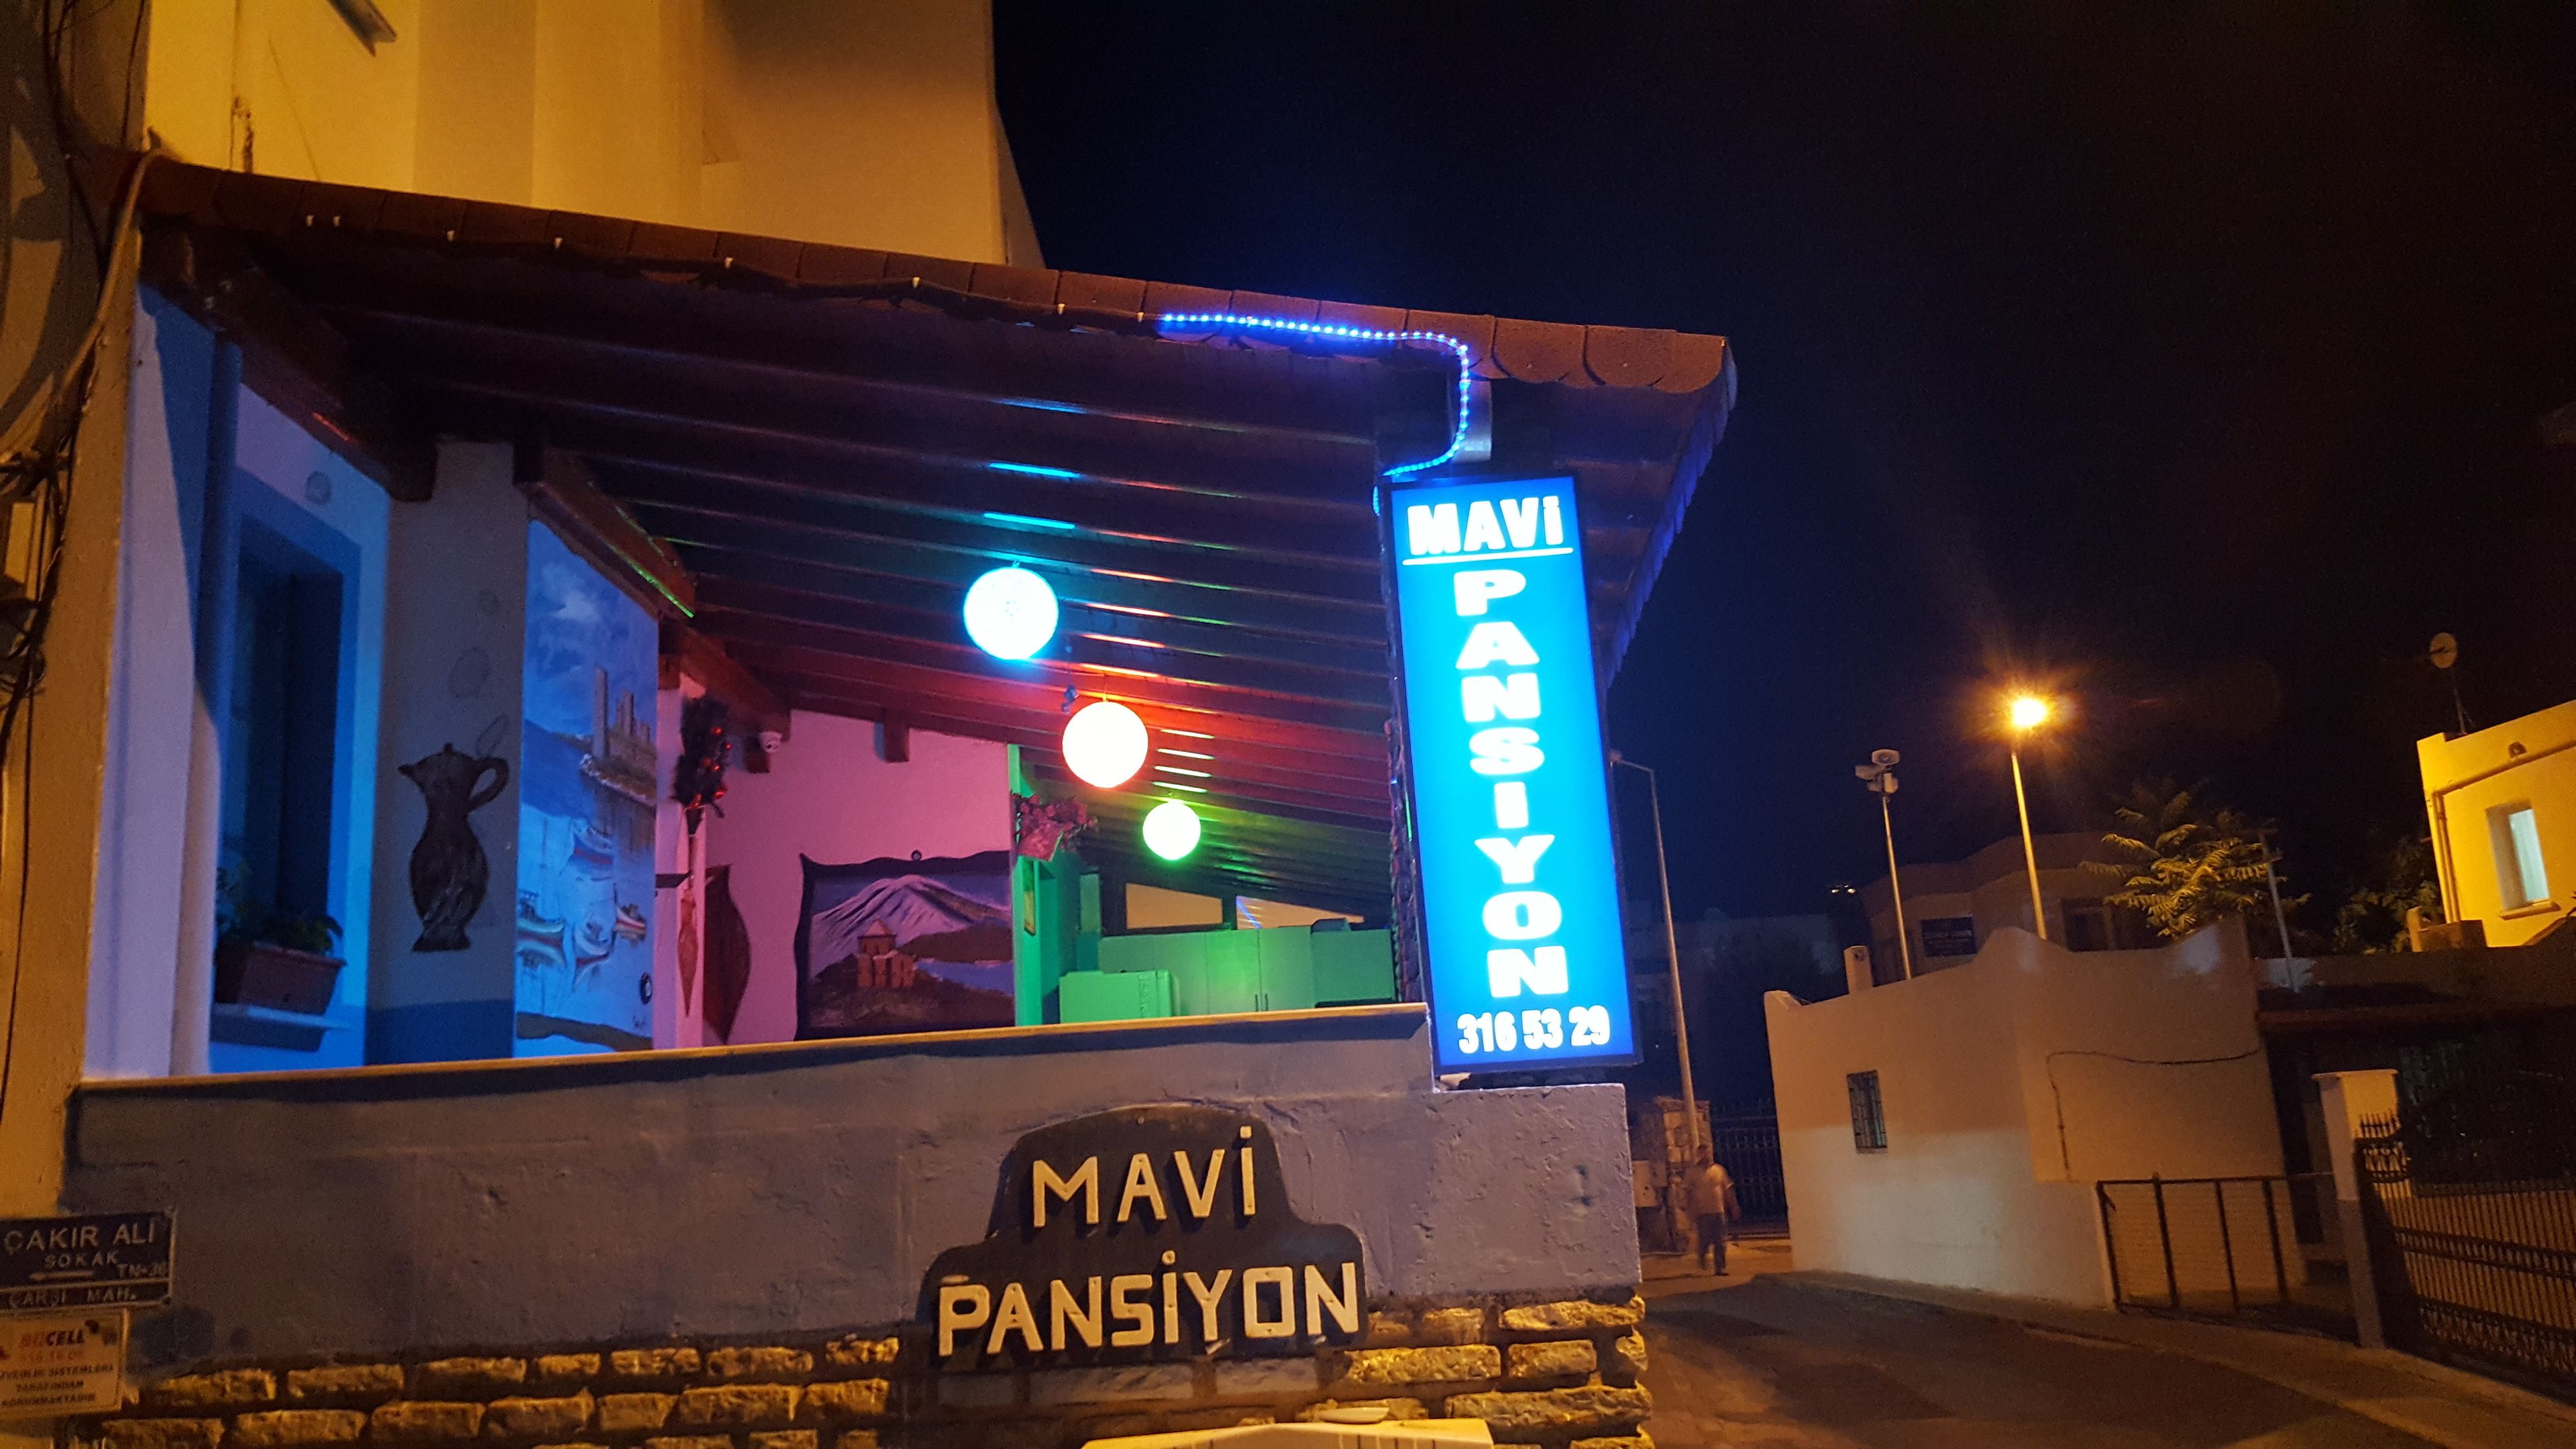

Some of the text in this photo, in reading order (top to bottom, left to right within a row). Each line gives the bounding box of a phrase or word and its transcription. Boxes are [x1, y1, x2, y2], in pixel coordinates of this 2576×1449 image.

[1456, 1004, 1610, 1054] 316 53 29
[45, 1250, 119, 1269] SOKAK
[939, 1250, 1359, 1357] PANSİYON
